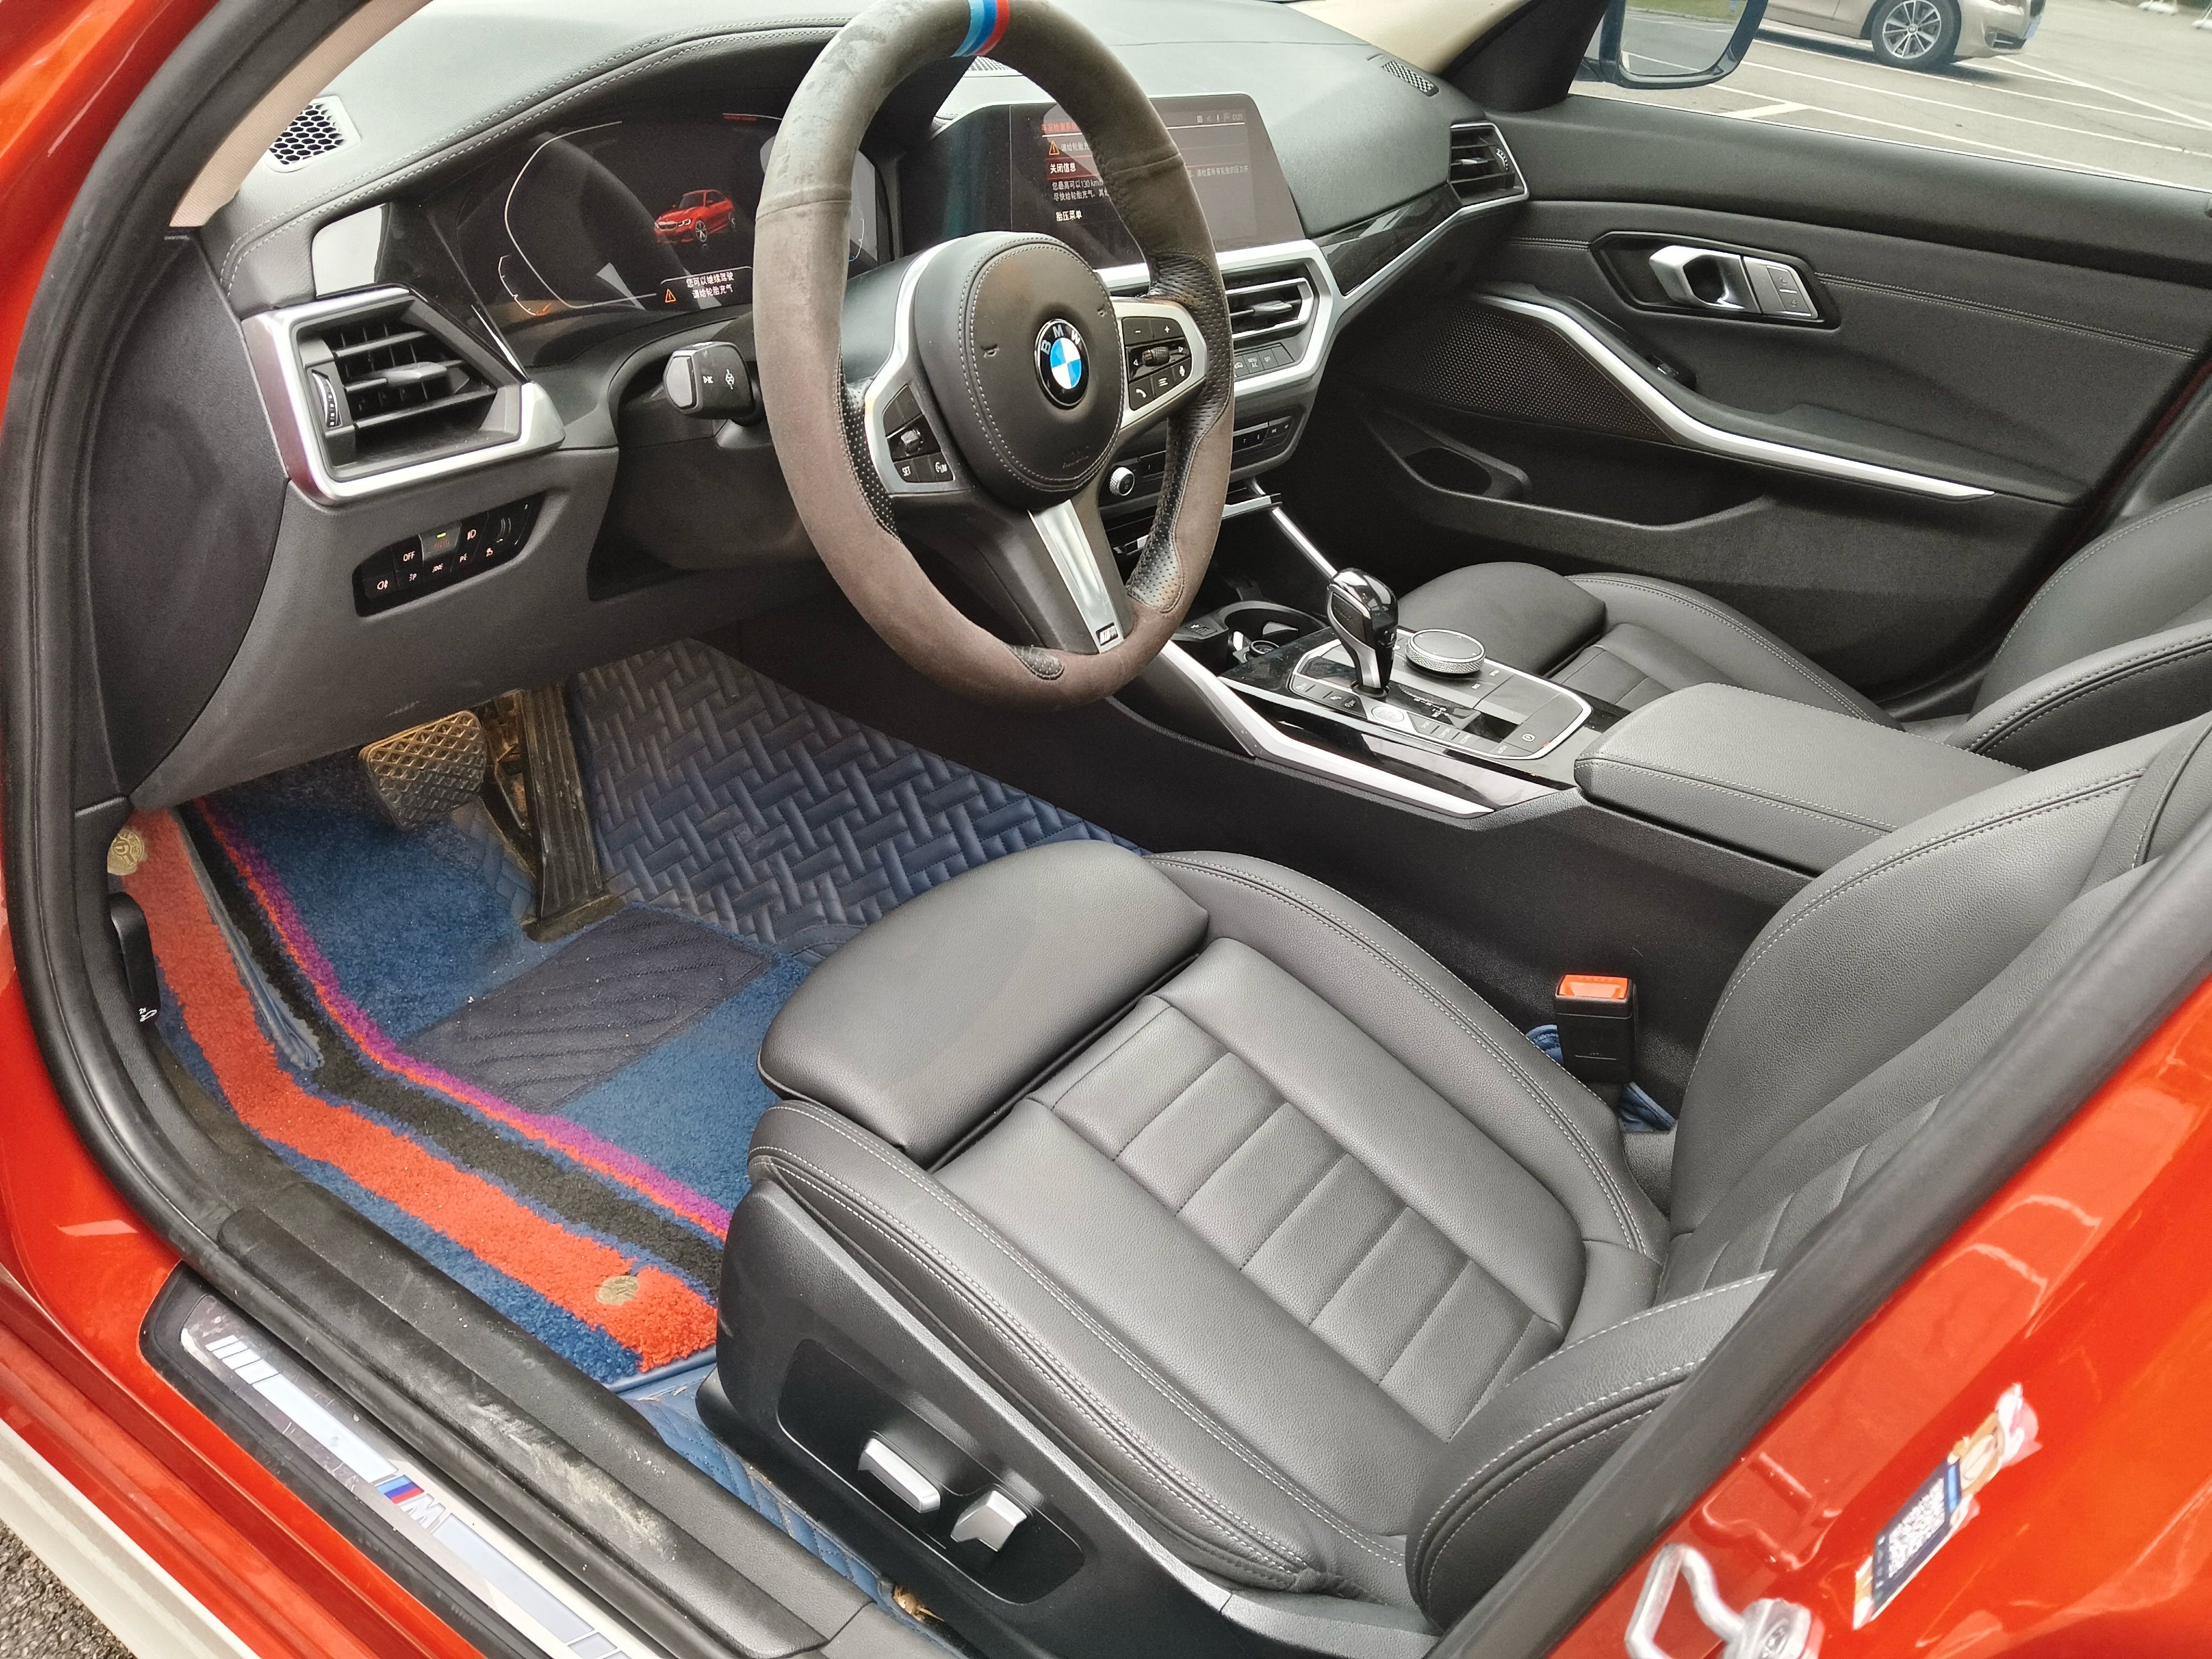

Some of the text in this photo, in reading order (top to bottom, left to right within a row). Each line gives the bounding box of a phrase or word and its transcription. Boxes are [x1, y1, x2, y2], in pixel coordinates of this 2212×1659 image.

[1050, 162, 1076, 173] 关闭信息
[1056, 210, 1082, 221] 胎压菜单
[686, 271, 734, 287] 您可以继续驾驶
[692, 284, 733, 298] 请给轮胎充气
[1040, 324, 1081, 355] BMW
[403, 551, 415, 562] OFF
[399, 1493, 446, 1529] M
